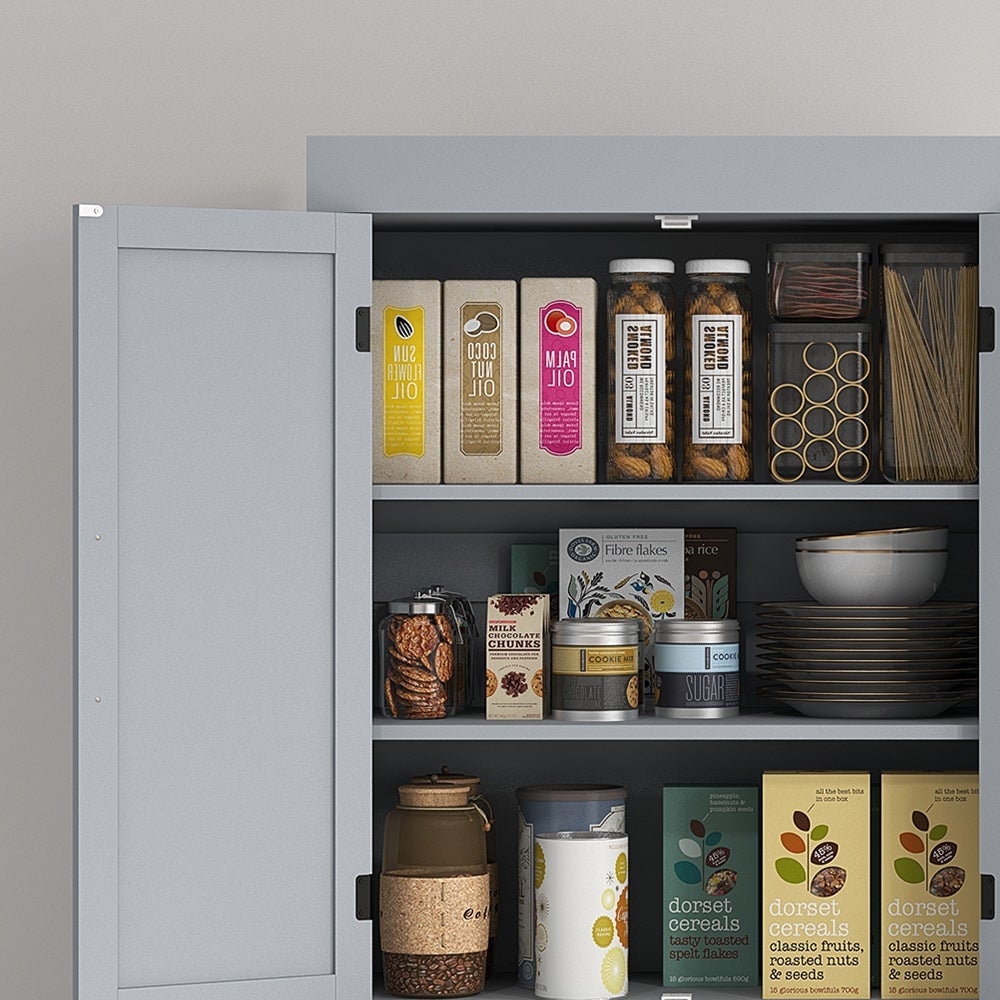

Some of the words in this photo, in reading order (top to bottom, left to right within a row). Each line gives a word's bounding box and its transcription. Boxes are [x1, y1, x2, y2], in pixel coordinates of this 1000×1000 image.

[605, 544, 633, 556] Fibre
[636, 544, 668, 556] flakes
[698, 543, 718, 555] rice
[488, 640, 540, 648] CHUNKS
[588, 655, 621, 663] COOKIE
[686, 674, 725, 701] SUGAR
[668, 897, 732, 913] dorset
[769, 899, 841, 916] dorset
[888, 899, 959, 916] dorset
[668, 916, 740, 932] cereals
[769, 919, 849, 937] cereals
[888, 919, 968, 937] cereals
[670, 935, 701, 947] tasty
[704, 935, 749, 946] toasted
[770, 940, 817, 952] classic
[821, 940, 864, 954] fruits,
[889, 940, 936, 952] classic
[670, 948, 700, 961] spelt
[702, 948, 739, 959] flakes
[770, 954, 823, 966] roasted
[826, 955, 859, 966] nuts
[889, 954, 942, 966] roasted
[945, 955, 978, 966] nuts
[770, 968, 782, 980] &
[785, 969, 824, 980] seeds
[889, 968, 901, 980] &
[904, 969, 943, 980] seeds
